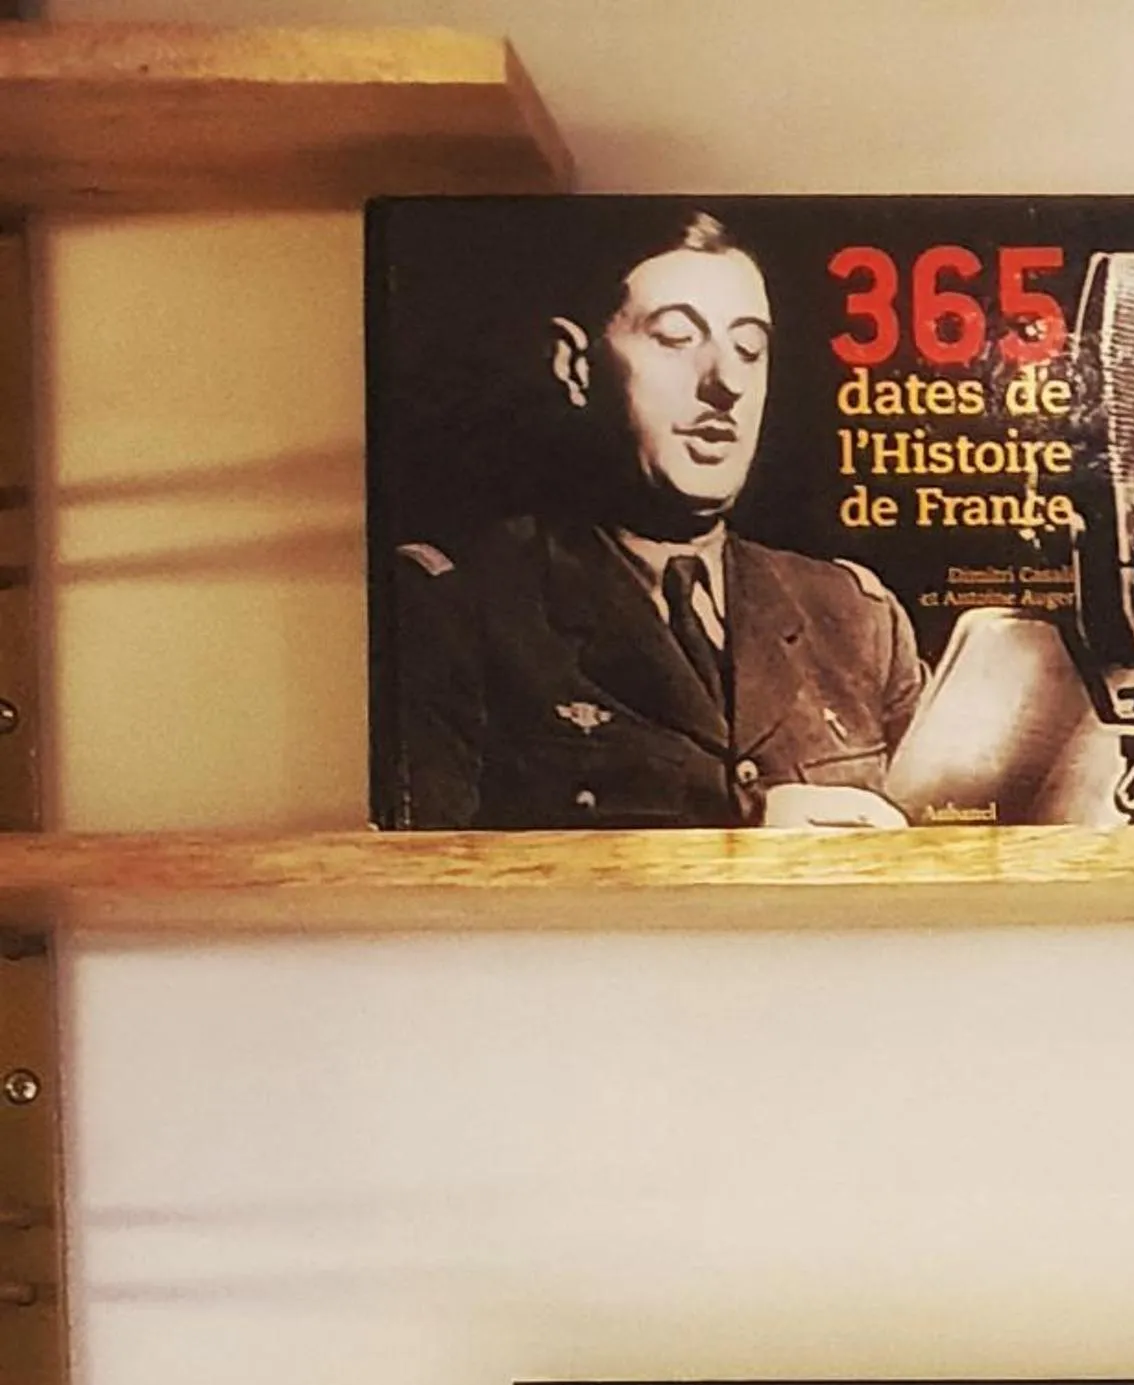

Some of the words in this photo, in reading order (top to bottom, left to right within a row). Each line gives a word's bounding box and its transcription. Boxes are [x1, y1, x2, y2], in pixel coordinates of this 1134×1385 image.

[828, 245, 1069, 365] 365
[837, 368, 984, 415] dates
[1005, 368, 1073, 415] de
[838, 428, 1073, 475] l'Histoire
[839, 488, 898, 527] de
[915, 488, 1075, 528] France
